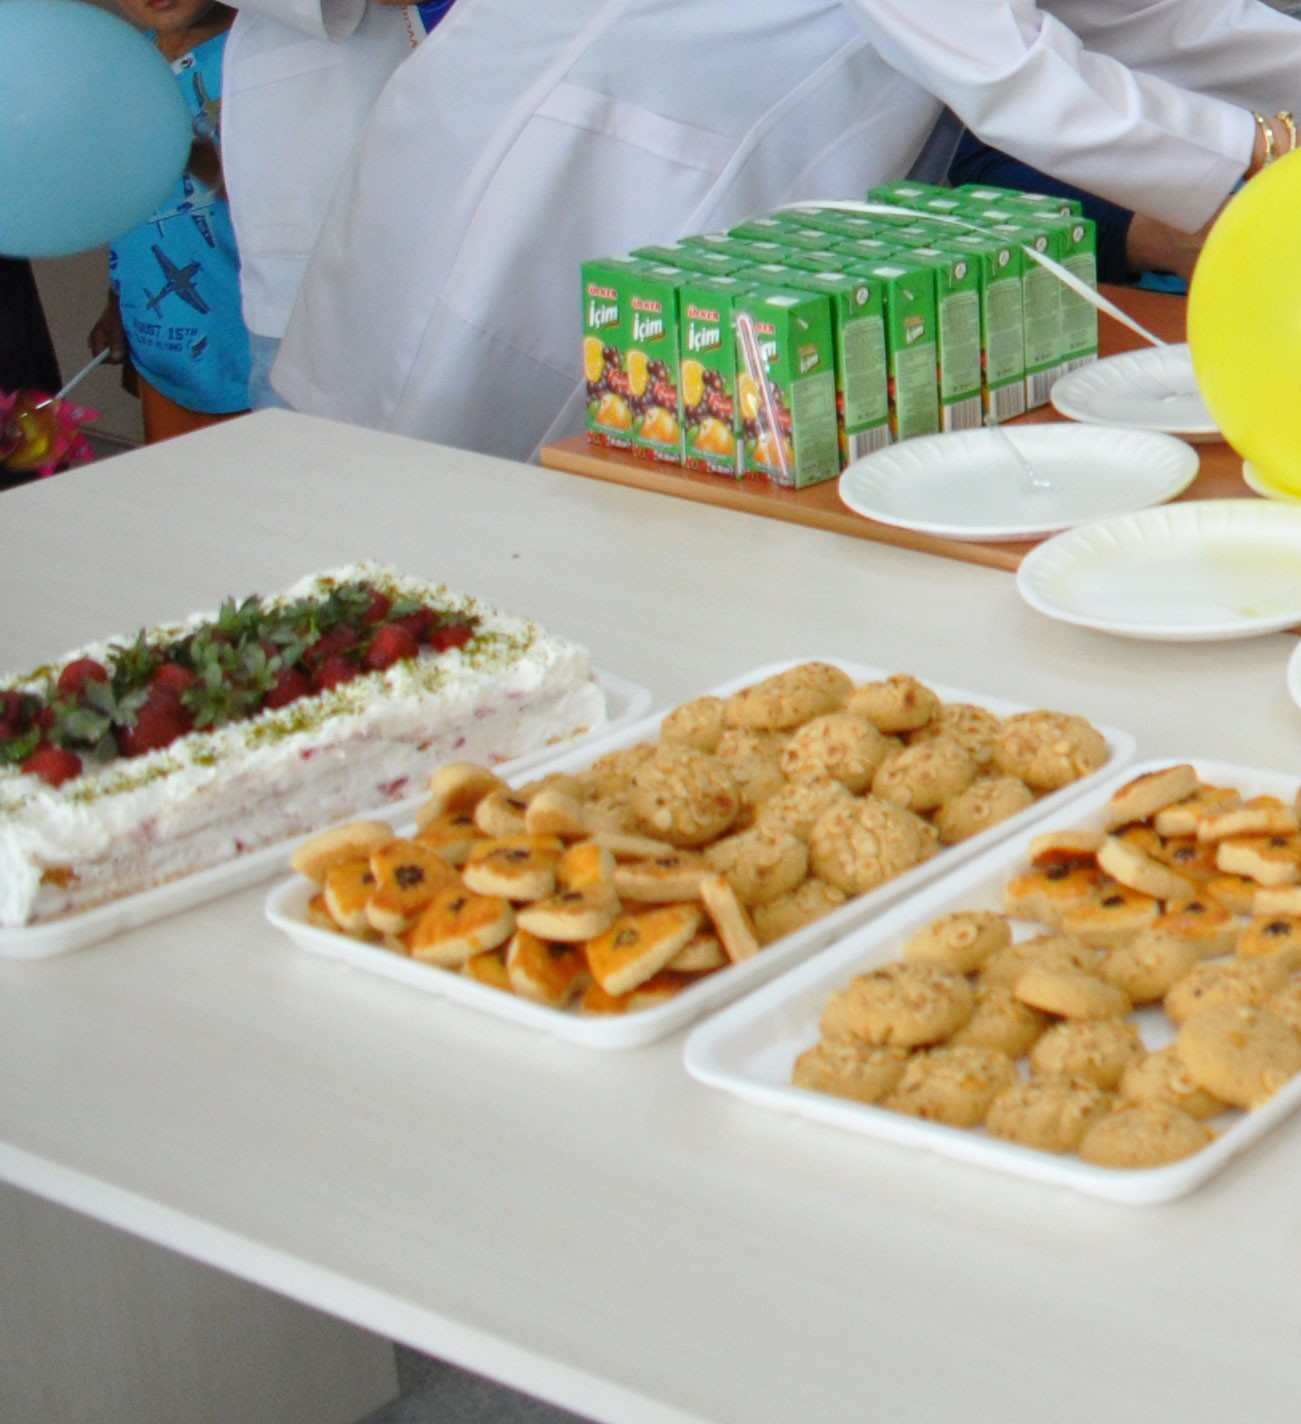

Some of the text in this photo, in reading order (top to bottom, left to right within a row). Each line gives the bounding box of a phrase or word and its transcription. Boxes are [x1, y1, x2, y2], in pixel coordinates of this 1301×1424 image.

[589, 300, 619, 329] İçim
[633, 313, 664, 342] İçim
[688, 322, 721, 352] İçim
